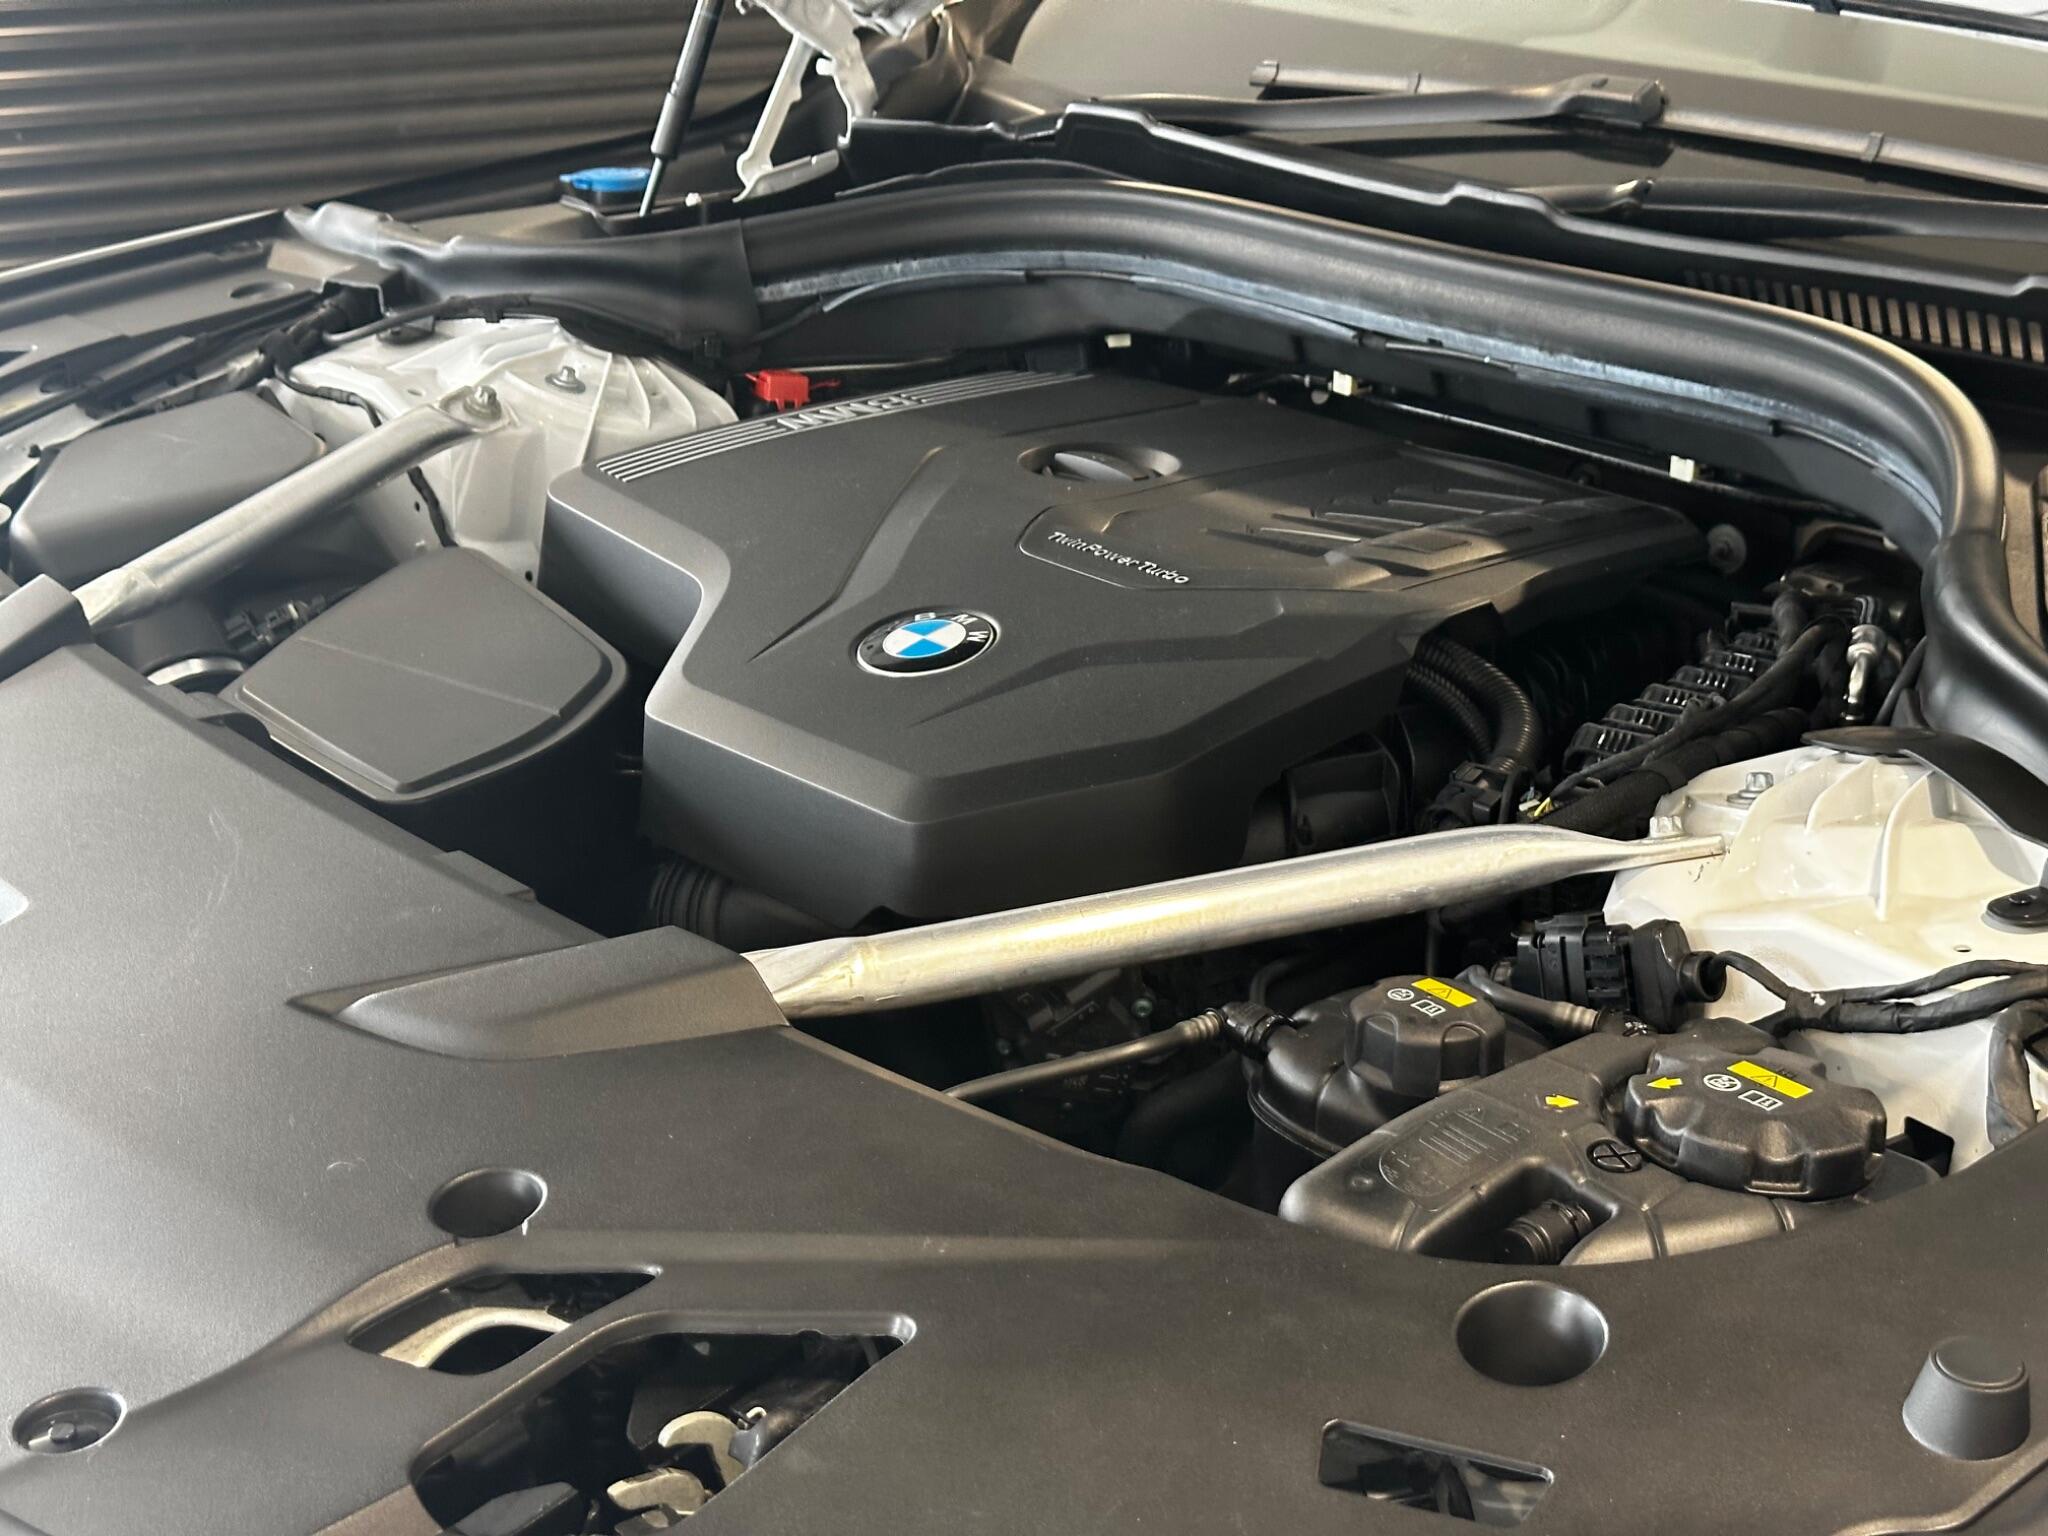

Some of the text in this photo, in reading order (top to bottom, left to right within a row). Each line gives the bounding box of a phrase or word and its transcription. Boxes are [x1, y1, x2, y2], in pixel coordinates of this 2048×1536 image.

[1047, 531, 1190, 585] TwinPower Turbo
[914, 611, 990, 643] BMW
